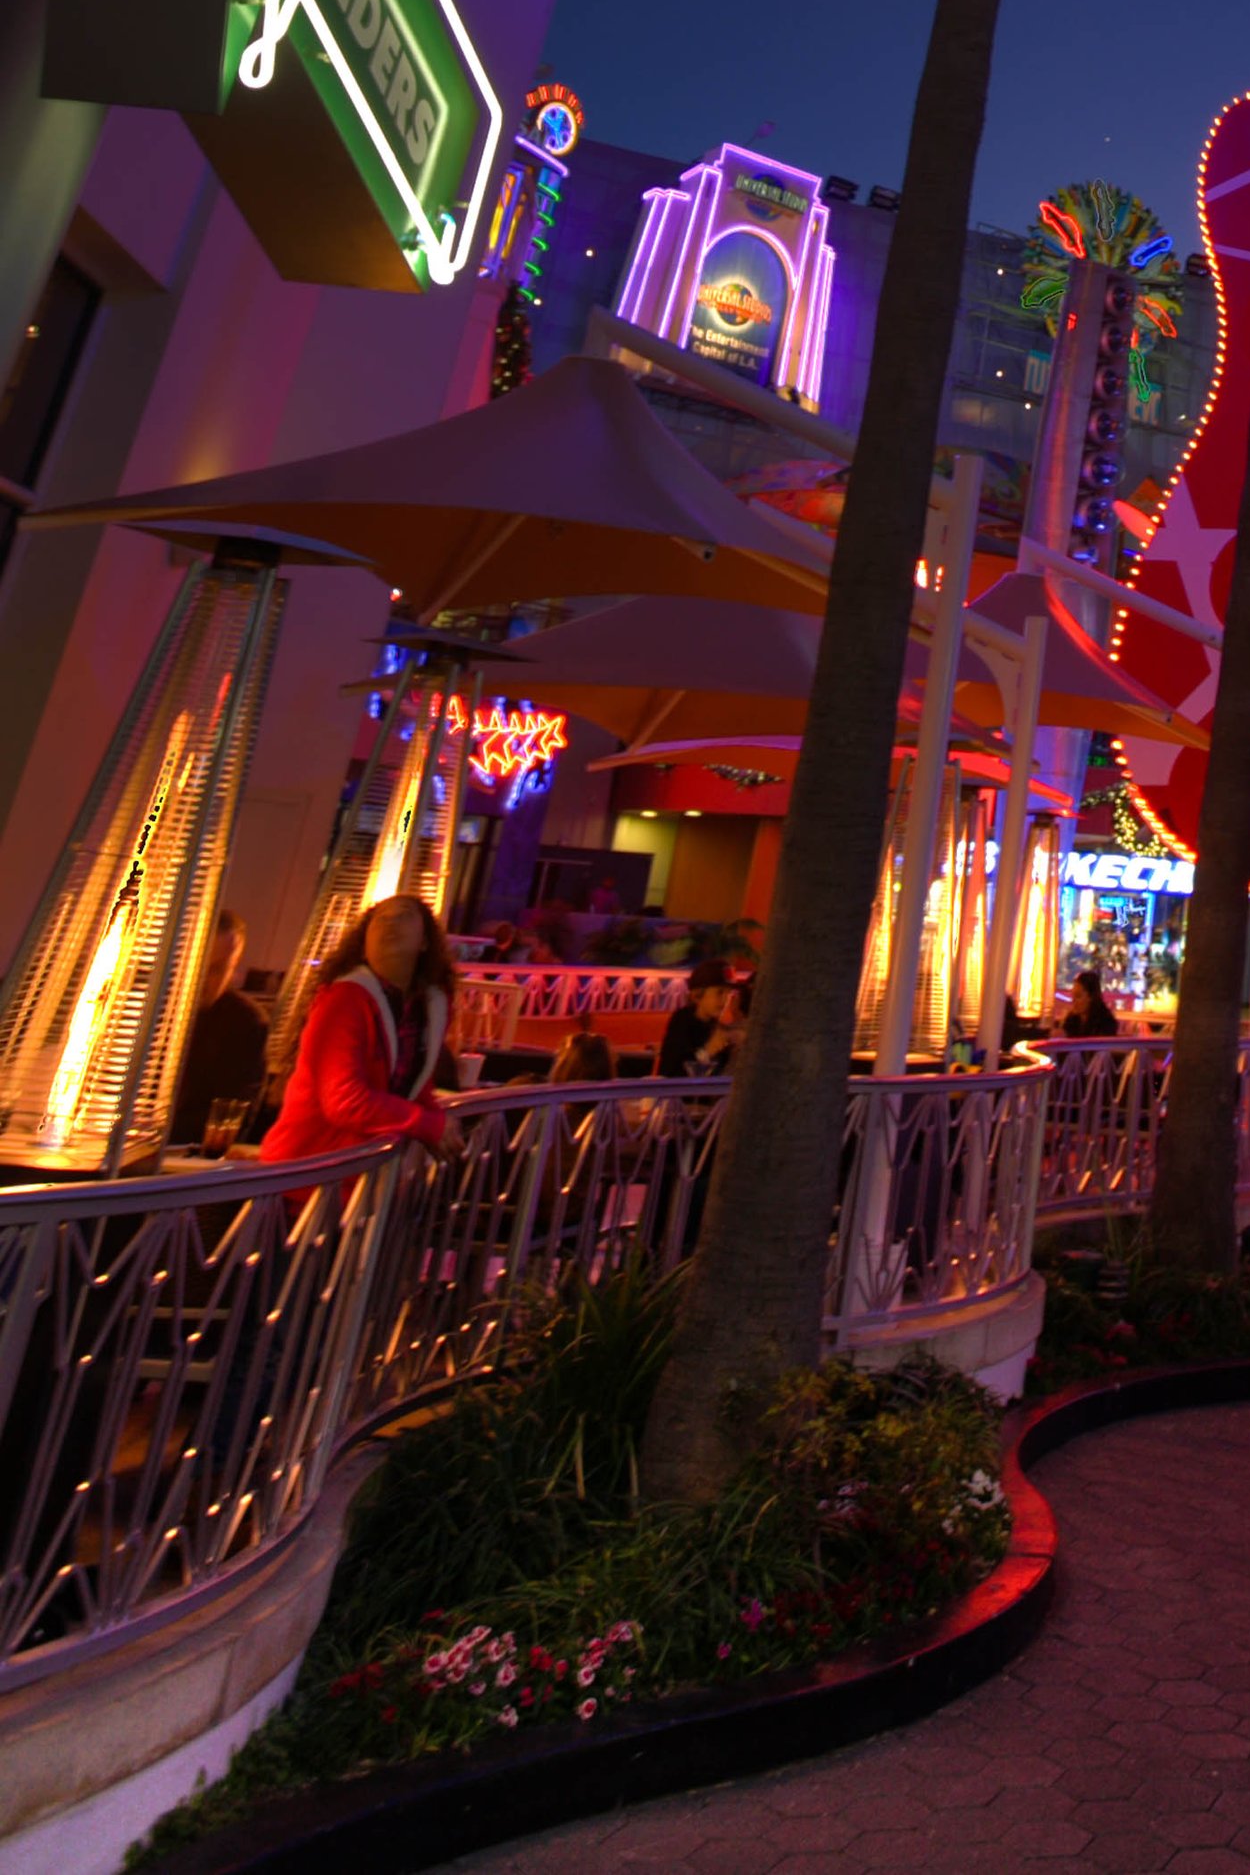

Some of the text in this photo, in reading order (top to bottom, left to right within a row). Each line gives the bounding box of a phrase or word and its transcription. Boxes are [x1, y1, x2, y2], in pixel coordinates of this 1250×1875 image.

[735, 174, 782, 202] UNIVERSAL
[697, 283, 742, 309] UNIVERSAL
[692, 341, 727, 361] Capital
[727, 353, 739, 364] of
[705, 329, 770, 357] Entertainment
